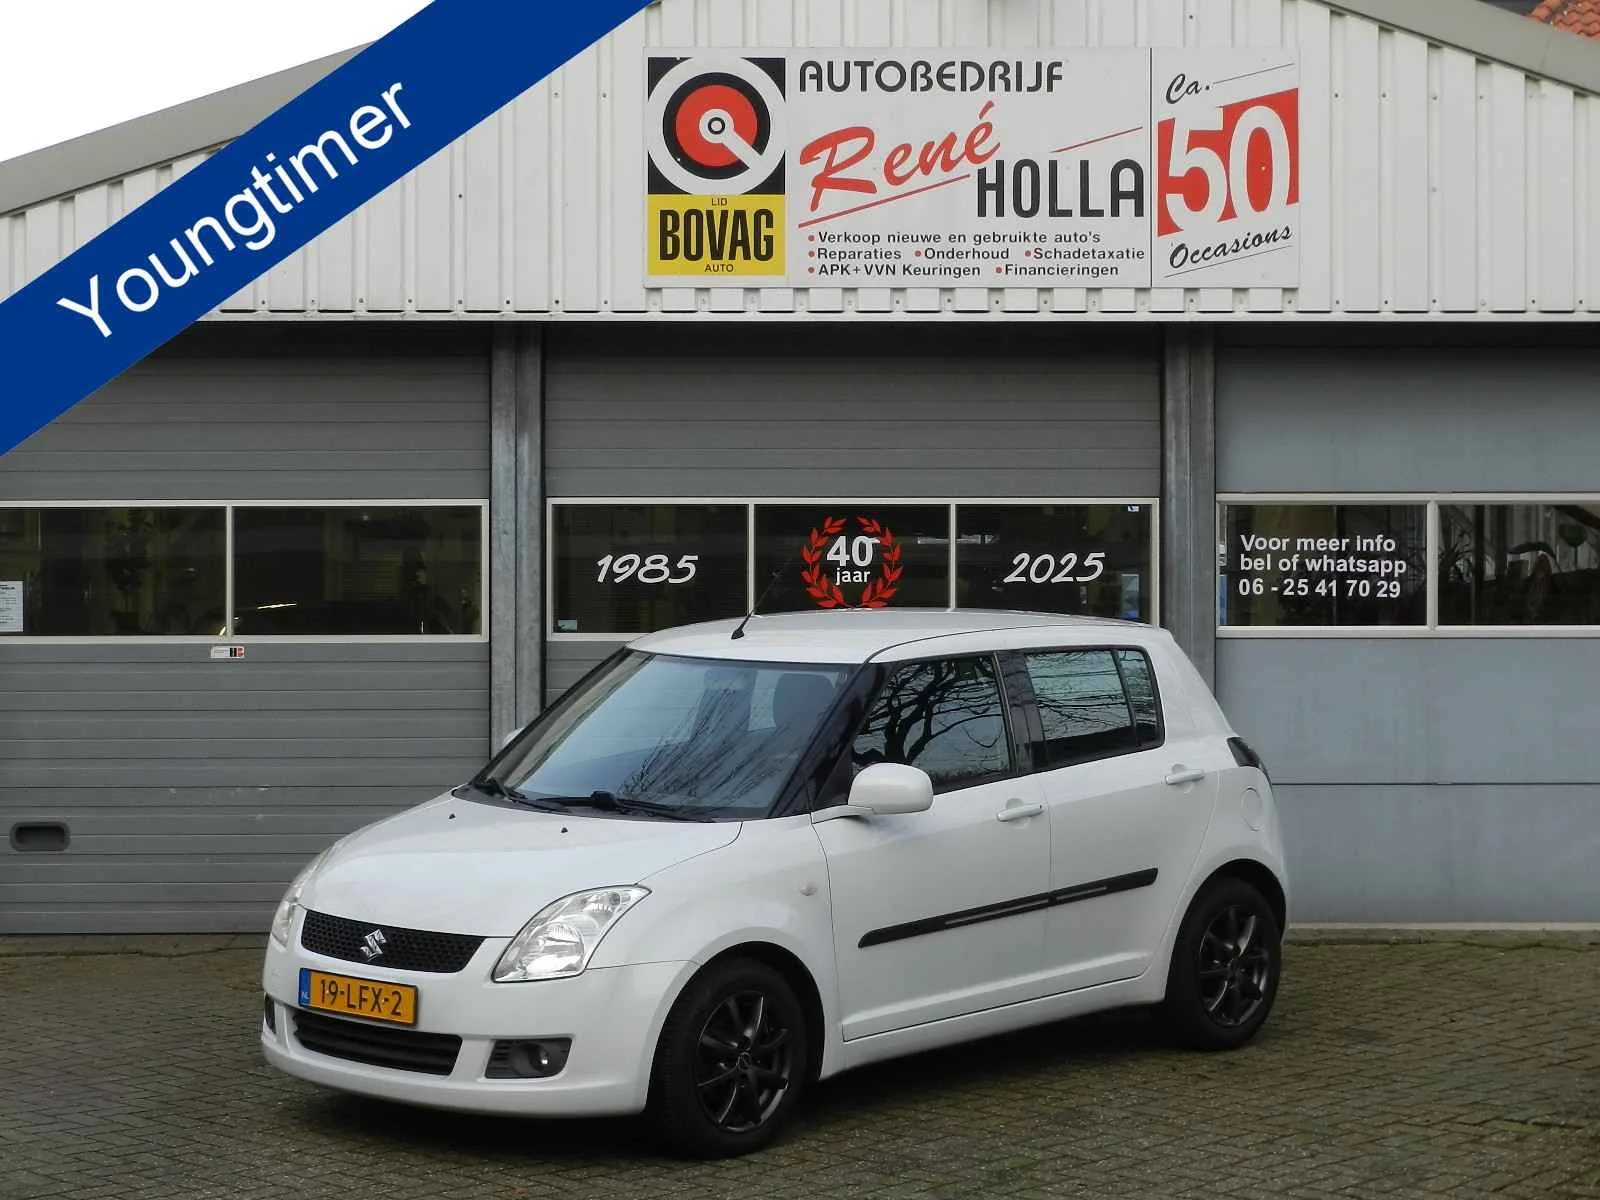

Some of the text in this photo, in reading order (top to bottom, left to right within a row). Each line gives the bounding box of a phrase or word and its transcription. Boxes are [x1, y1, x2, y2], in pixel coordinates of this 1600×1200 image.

[800, 60, 1063, 93] AUTOBEDRIJF
[1166, 73, 1211, 104] Ca.
[799, 100, 1001, 212] René
[1166, 104, 1292, 225] 50
[977, 158, 1145, 218] HOLLA
[711, 197, 728, 206] LID
[659, 208, 774, 261] BOVAG
[818, 231, 1101, 245] Verkoop nieuwe en gebruikte auto's
[817, 247, 902, 261] Reparaties
[924, 247, 1010, 260] Onderhoud
[1033, 247, 1145, 260] Schadetaxatie
[1169, 225, 1293, 269] Occasions
[704, 263, 734, 273] AUTO
[902, 263, 981, 278] Keuringen
[1004, 263, 1119, 278] Financieringen
[826, 535, 881, 567] 40
[1240, 534, 1396, 552] Voor meer Info
[596, 553, 699, 584] 1985
[835, 567, 871, 586] jaar
[1003, 552, 1106, 584] 2025
[1240, 553, 1407, 577] bel of whatsapp
[1239, 578, 1264, 596] 06
[1282, 578, 1309, 596] 25
[1315, 579, 1337, 597] 41
[1346, 579, 1370, 597] 70
[1376, 580, 1401, 598] 29
[320, 979, 402, 1016] 19-LFX-2
